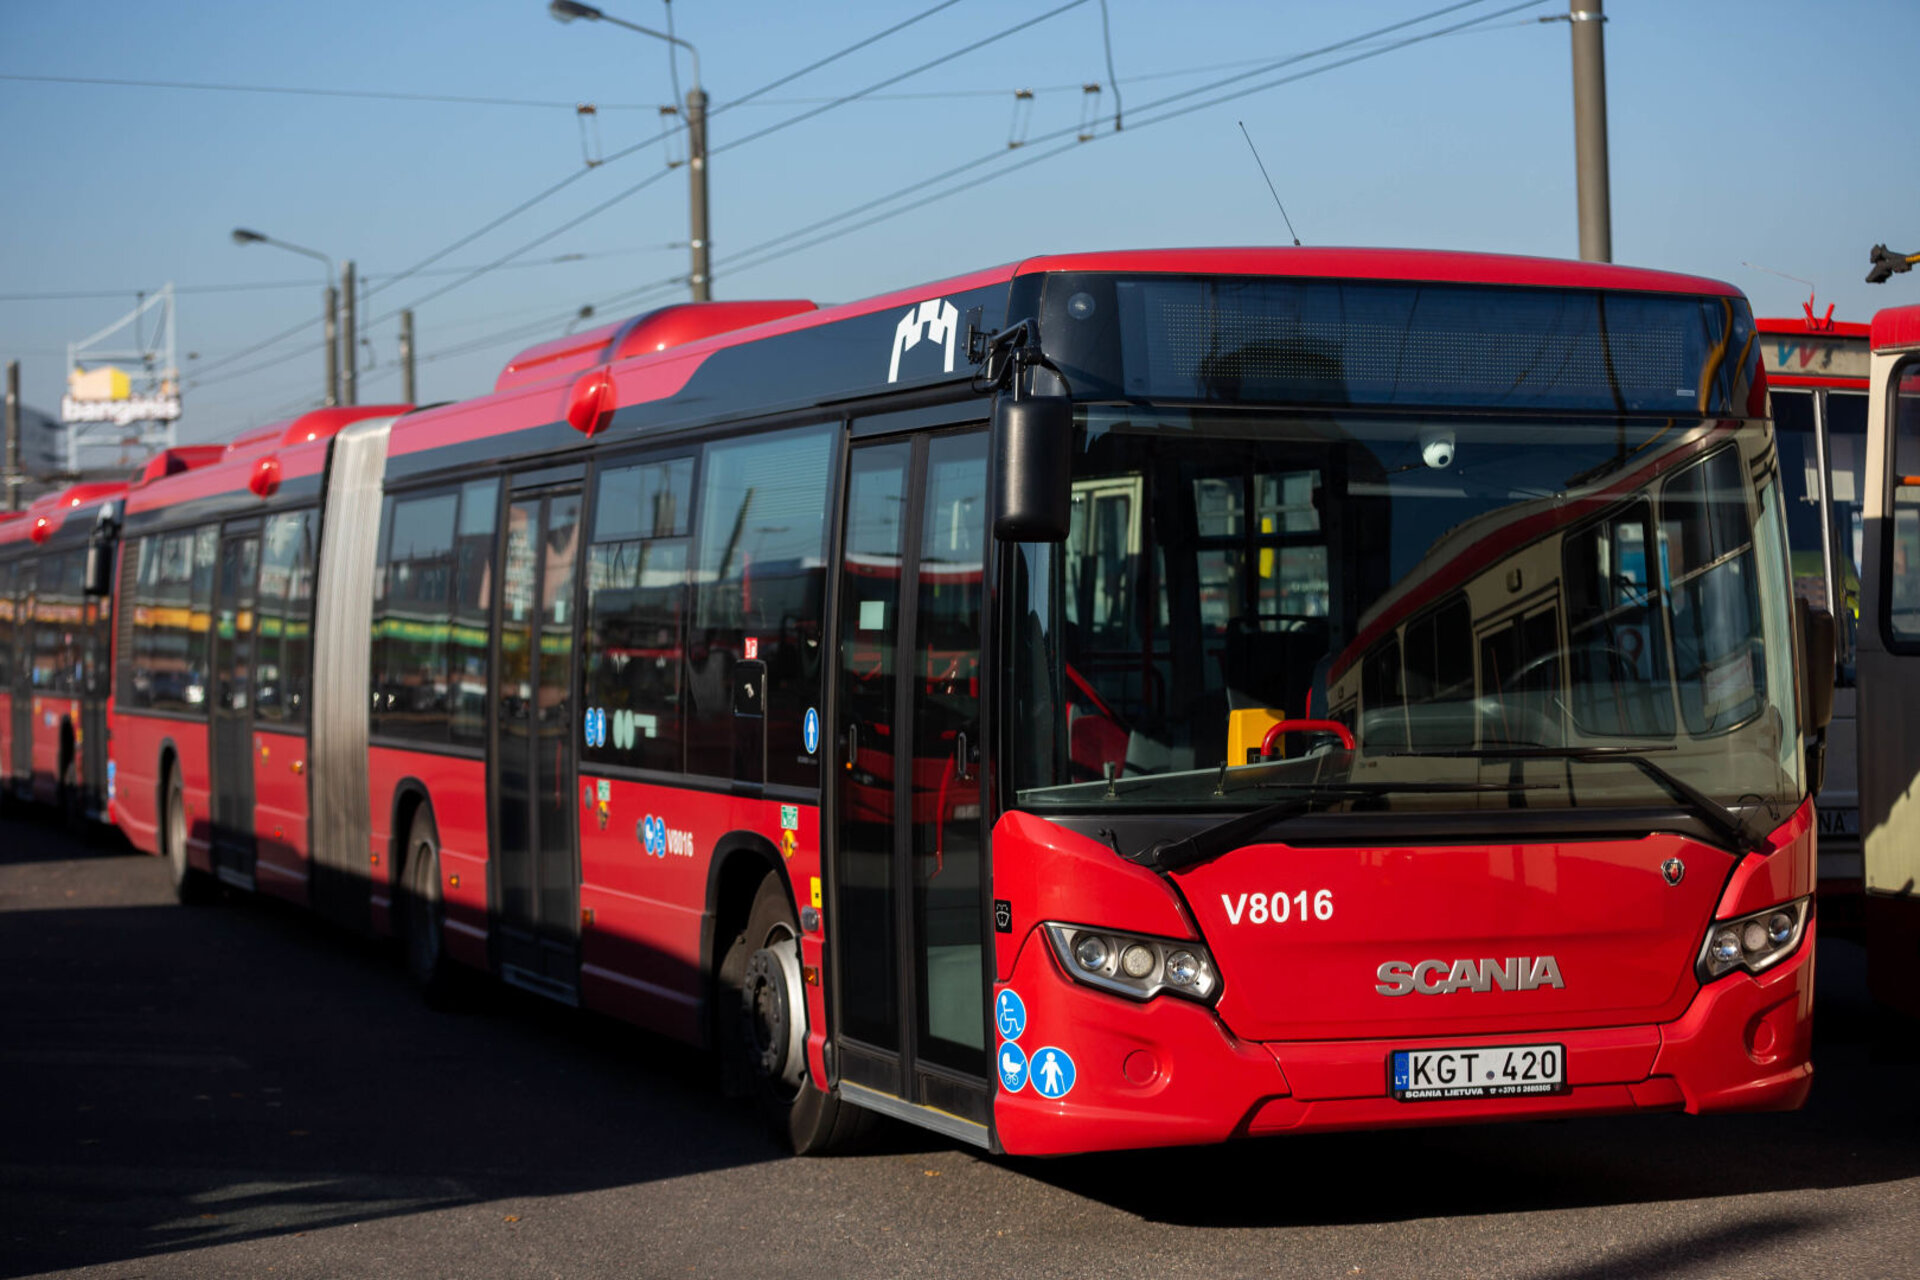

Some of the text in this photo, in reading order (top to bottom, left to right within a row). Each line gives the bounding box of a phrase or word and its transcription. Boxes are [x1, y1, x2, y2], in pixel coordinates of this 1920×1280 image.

[667, 829, 694, 857] V8016
[1221, 889, 1334, 925] V8016
[1375, 956, 1566, 996] SCANIA
[1395, 1075, 1408, 1085] LT
[1413, 1050, 1557, 1085] KGT 420
[1405, 1090, 1442, 1098] SCANIA
[1444, 1088, 1484, 1097] LIETUVA
